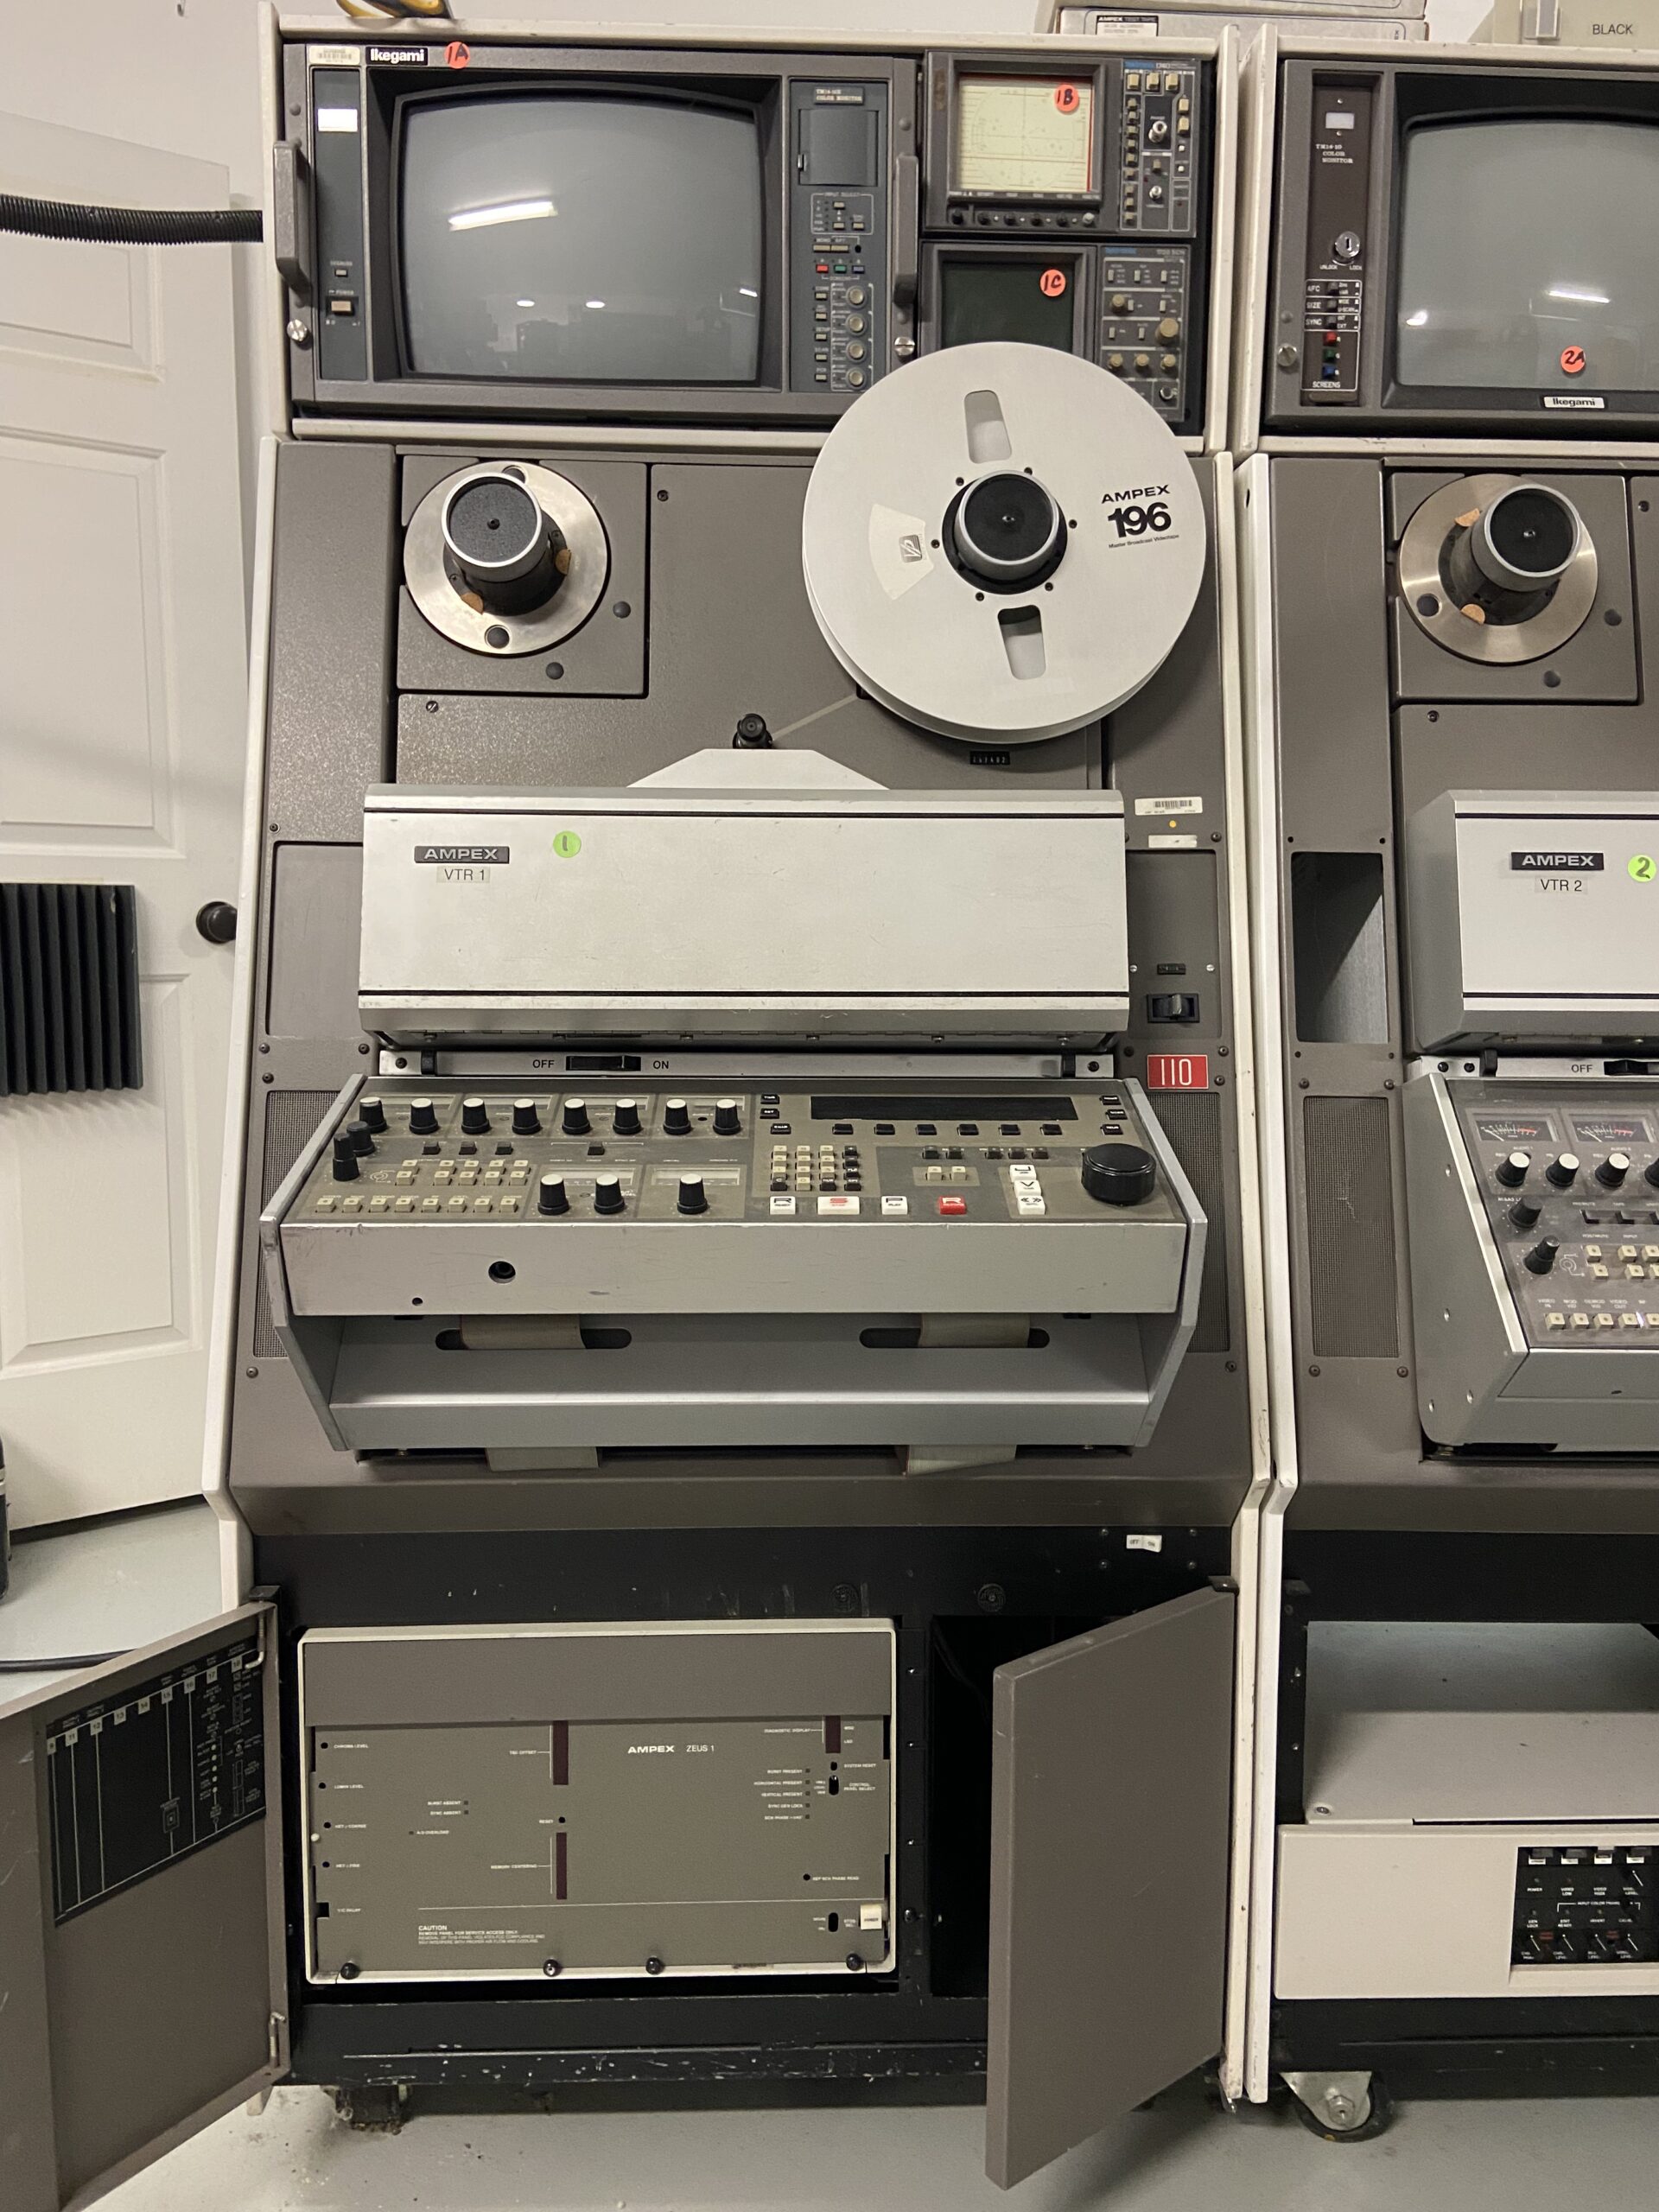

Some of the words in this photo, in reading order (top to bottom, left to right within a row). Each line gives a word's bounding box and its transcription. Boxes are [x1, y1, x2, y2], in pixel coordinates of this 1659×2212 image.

[1592, 23, 1633, 35] BLACK
[370, 48, 424, 62] Ikegami
[448, 44, 468, 62] 1A
[1056, 88, 1074, 105] 1B
[1043, 274, 1062, 292] 1C
[1565, 350, 1585, 365] 2A
[1553, 397, 1596, 407] Ikegami
[1101, 484, 1171, 505] AMPEX
[1107, 501, 1172, 538] 196
[1127, 537, 1153, 546] Broadcast
[1154, 533, 1179, 543] Videotape
[423, 848, 499, 861] AMPEX
[1522, 855, 1594, 867] AMPEX
[444, 868, 474, 881] VTR
[479, 869, 486, 881] 1
[1636, 856, 1651, 880] 2
[1541, 879, 1569, 891] VTR
[1573, 880, 1582, 892] 2
[532, 1059, 556, 1069] OFF
[652, 1060, 670, 1070] ON
[1571, 1064, 1593, 1074] OFF
[1160, 1058, 1192, 1086] 110
[627, 1745, 675, 1754] AMPEX
